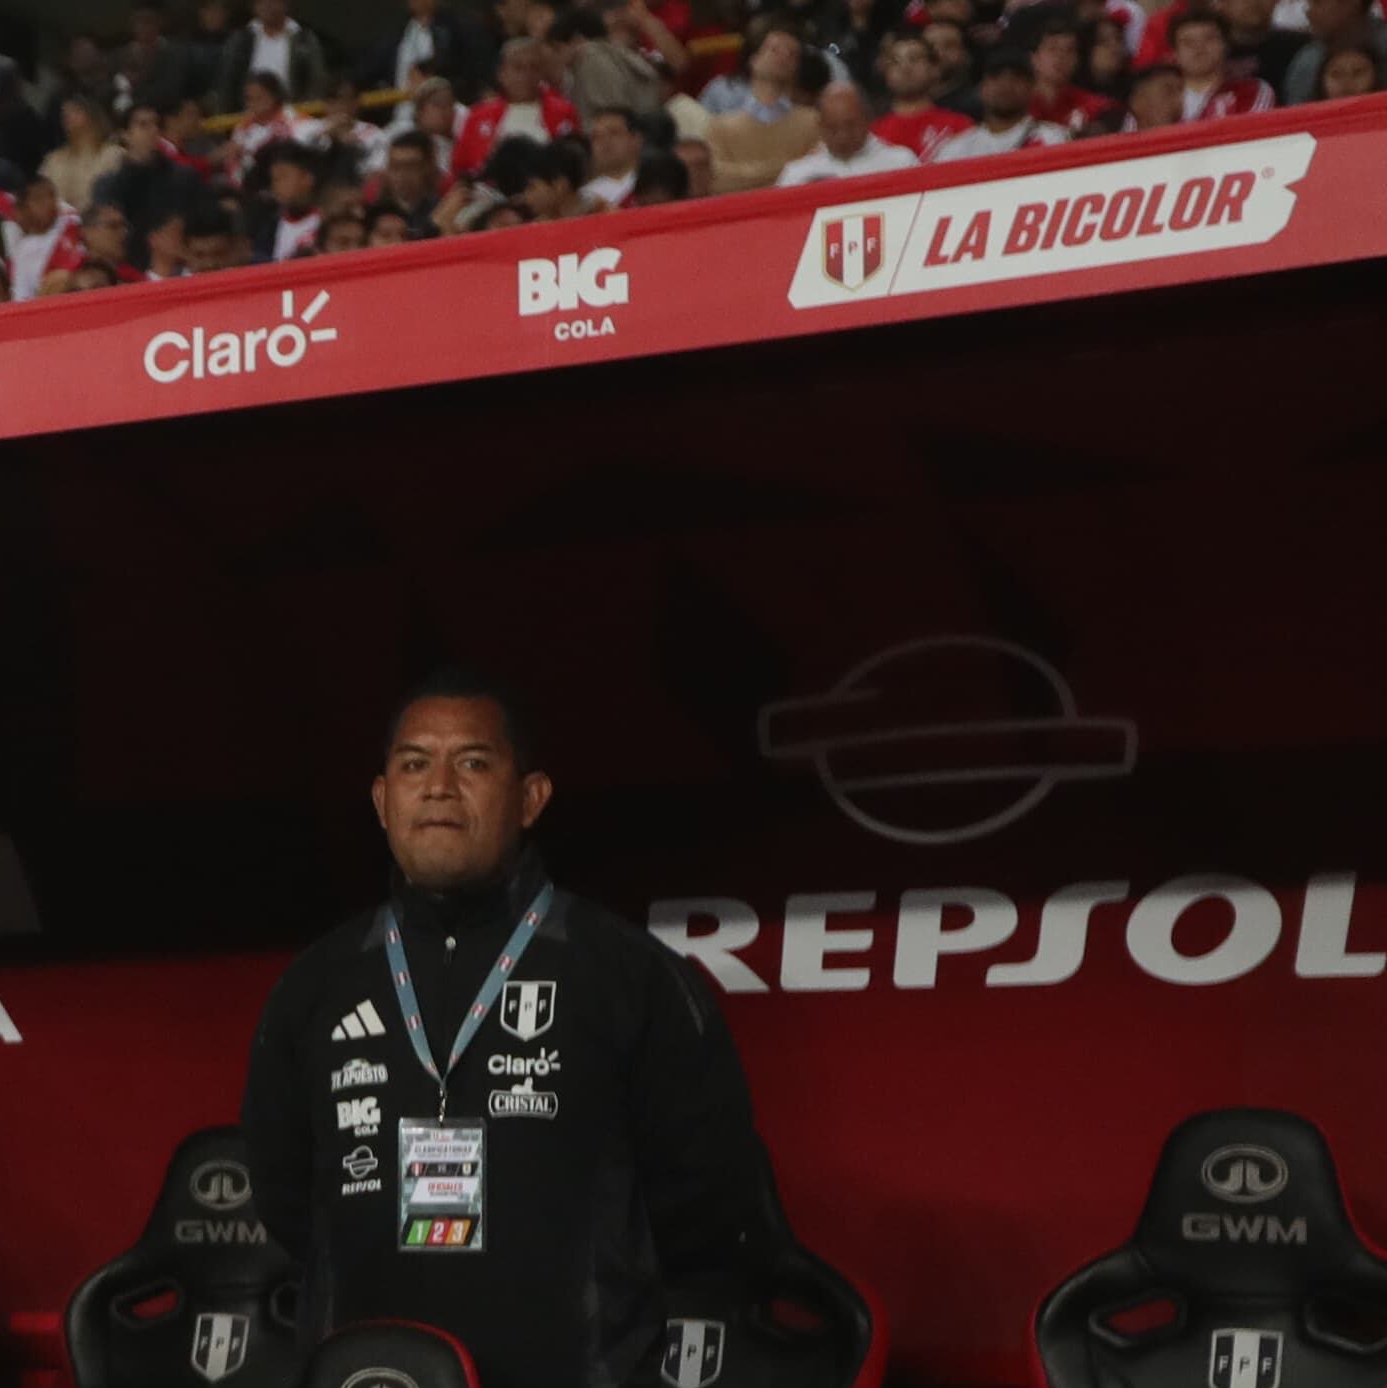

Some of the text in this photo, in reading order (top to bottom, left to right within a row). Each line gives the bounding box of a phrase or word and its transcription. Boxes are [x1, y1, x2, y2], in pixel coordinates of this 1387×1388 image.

[923, 170, 1256, 268] LA BICOLOR
[517, 247, 630, 316] BIG
[554, 316, 616, 341] COLA
[144, 323, 307, 383] Claro
[648, 872, 1387, 994] REPSOL
[488, 1053, 551, 1077] Claro
[337, 1097, 381, 1130] BIG
[494, 1094, 553, 1114] CRISTAL
[175, 1219, 267, 1244] GWM
[432, 1221, 445, 1244] 2
[452, 1221, 464, 1244] 3
[1182, 1213, 1307, 1245] GWM
[1218, 1355, 1273, 1375] FPF
